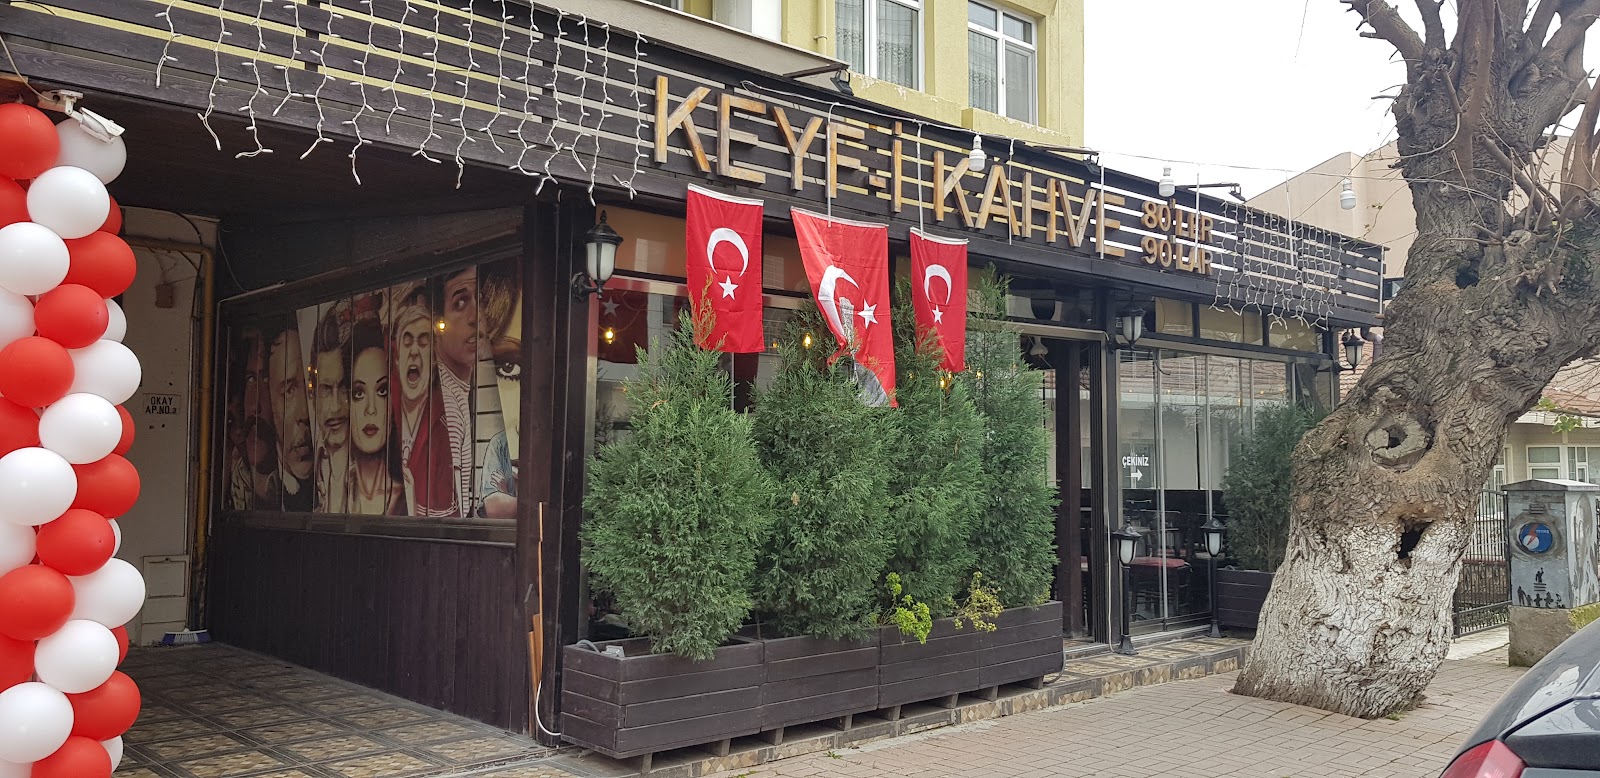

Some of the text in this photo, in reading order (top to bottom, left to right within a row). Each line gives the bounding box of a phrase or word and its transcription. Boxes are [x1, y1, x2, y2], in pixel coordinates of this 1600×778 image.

[654, 75, 1126, 258] KEYF-İ KAHVE
[1141, 198, 1214, 244] 80'LER
[1141, 235, 1214, 276] 90'LAR
[150, 396, 174, 406] OKAY
[1122, 454, 1150, 469] ÇEKİNİZ
